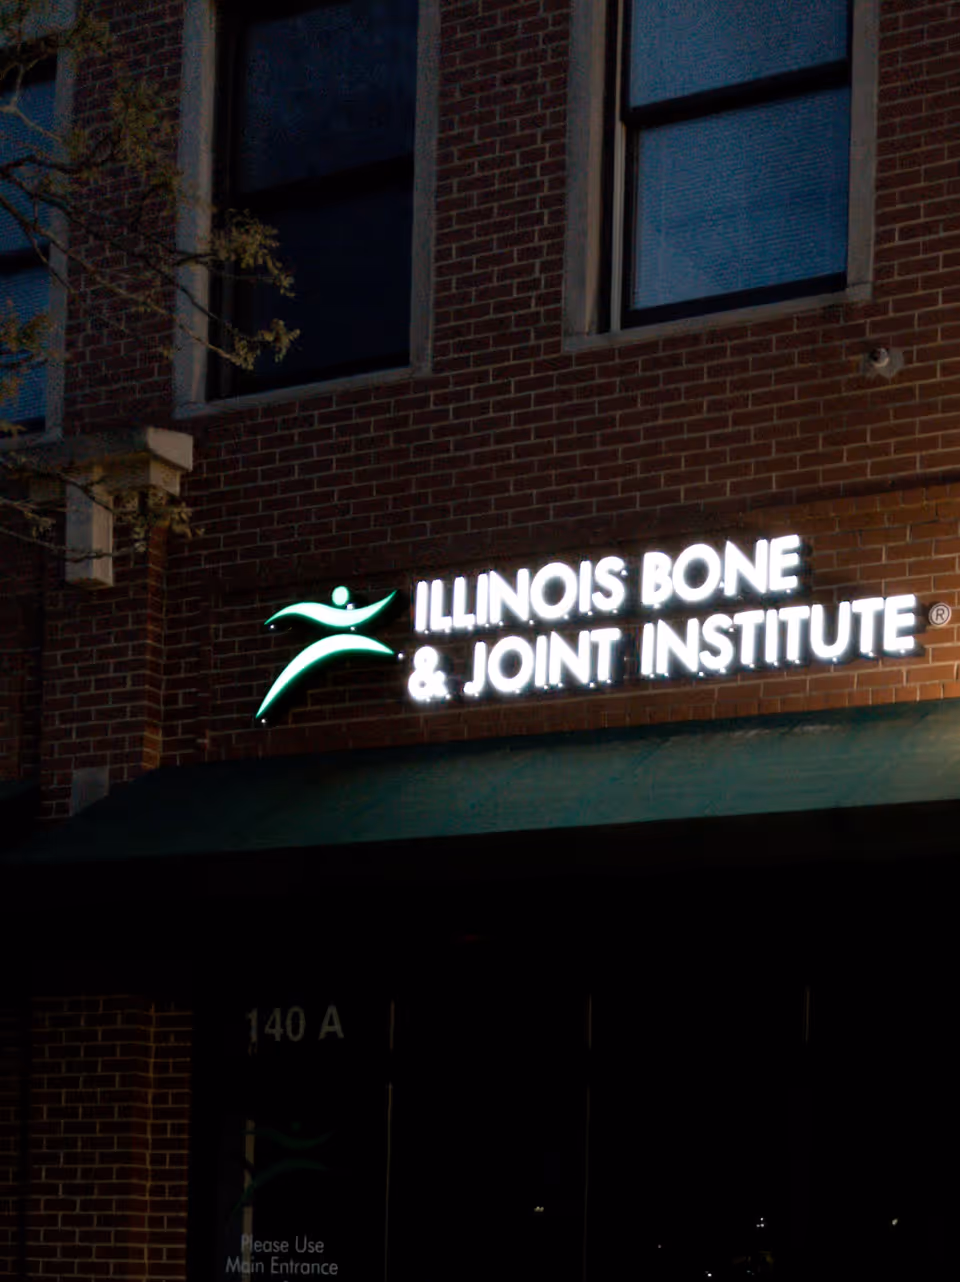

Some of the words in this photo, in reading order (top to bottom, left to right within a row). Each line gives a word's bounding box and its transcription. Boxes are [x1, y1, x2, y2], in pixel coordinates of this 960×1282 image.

[414, 556, 625, 632] ILLINOIS
[641, 534, 800, 608] BONE
[408, 645, 447, 702] &
[463, 628, 621, 697] JOINT
[640, 594, 917, 677] INSTITUTE
[245, 1005, 306, 1042] 140
[317, 1003, 345, 1041] A
[240, 1233, 289, 1253] Please
[295, 1233, 325, 1253] Use
[225, 1256, 265, 1274] Main
[270, 1256, 338, 1276] Entrance
